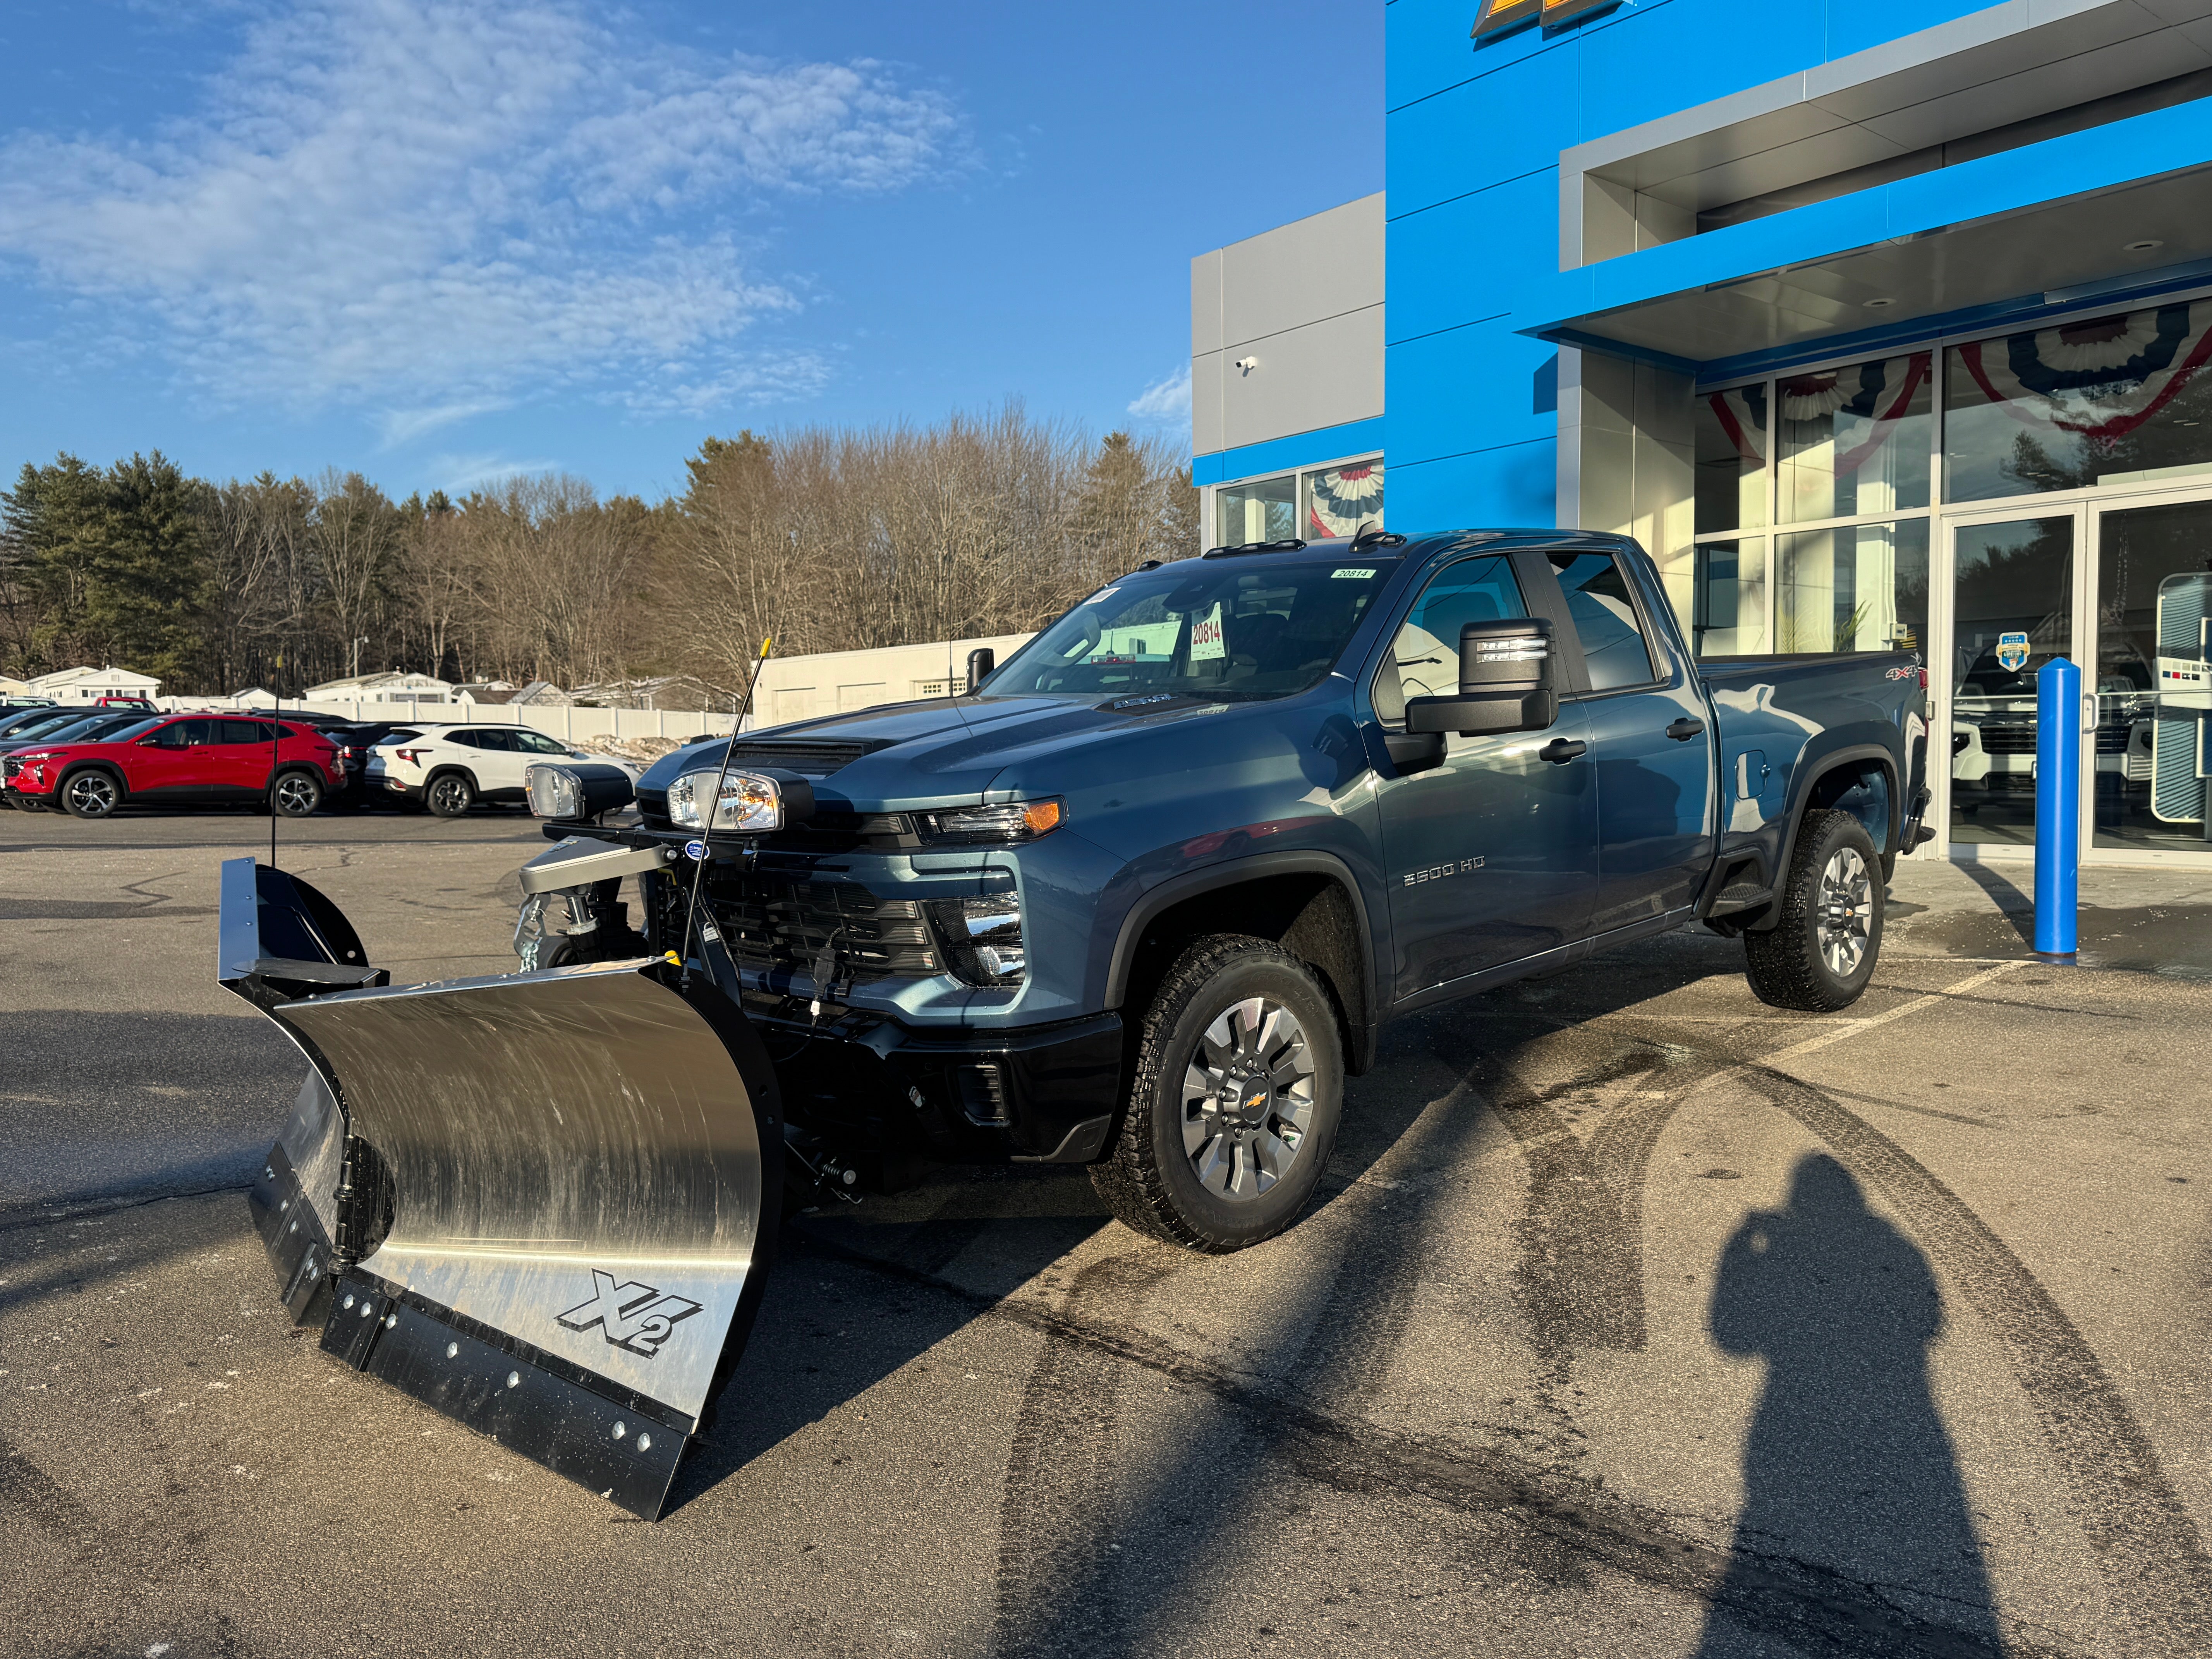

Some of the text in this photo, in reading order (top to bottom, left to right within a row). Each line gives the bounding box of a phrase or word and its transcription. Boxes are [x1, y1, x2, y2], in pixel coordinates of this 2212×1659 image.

[1193, 620, 1220, 645] 20814
[1403, 856, 1485, 887] 2500 HD
